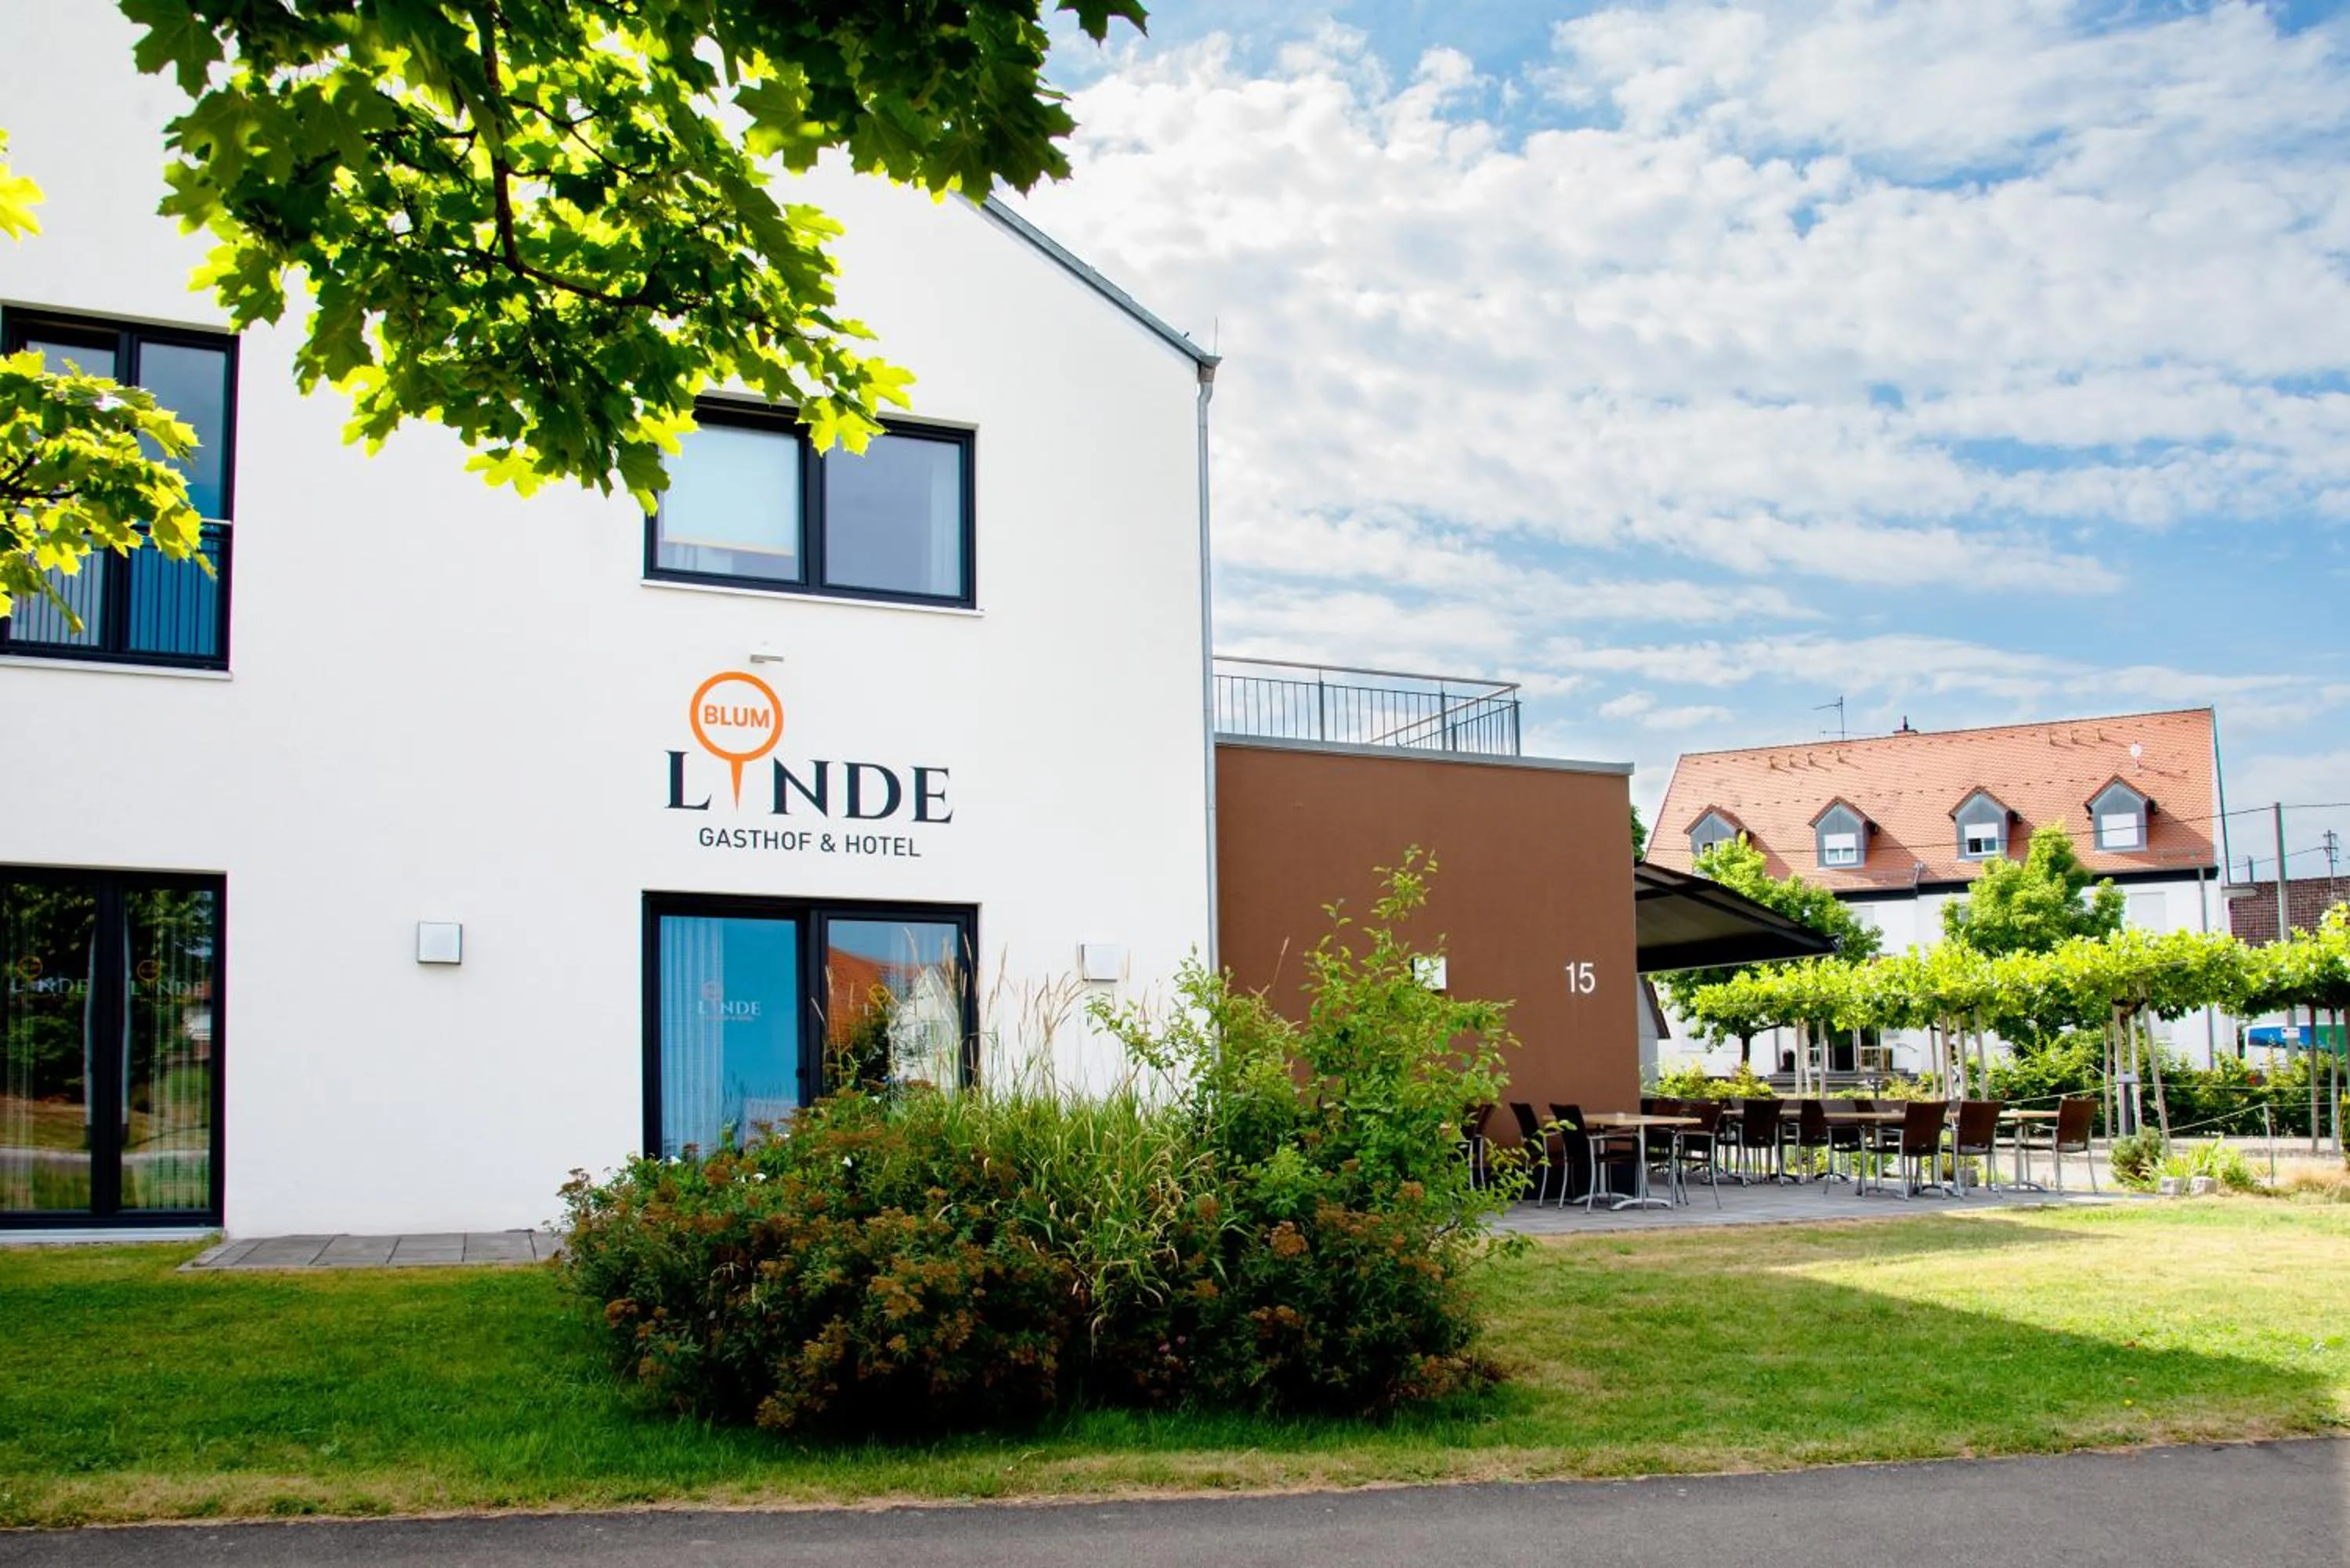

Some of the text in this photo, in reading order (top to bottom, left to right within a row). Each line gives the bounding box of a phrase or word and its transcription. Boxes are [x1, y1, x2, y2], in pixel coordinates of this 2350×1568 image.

[704, 704, 770, 728] BLUM
[699, 827, 922, 858] GASTHOF & HOTEL
[9, 977, 89, 996] LNDE
[1566, 962, 1596, 994] 15
